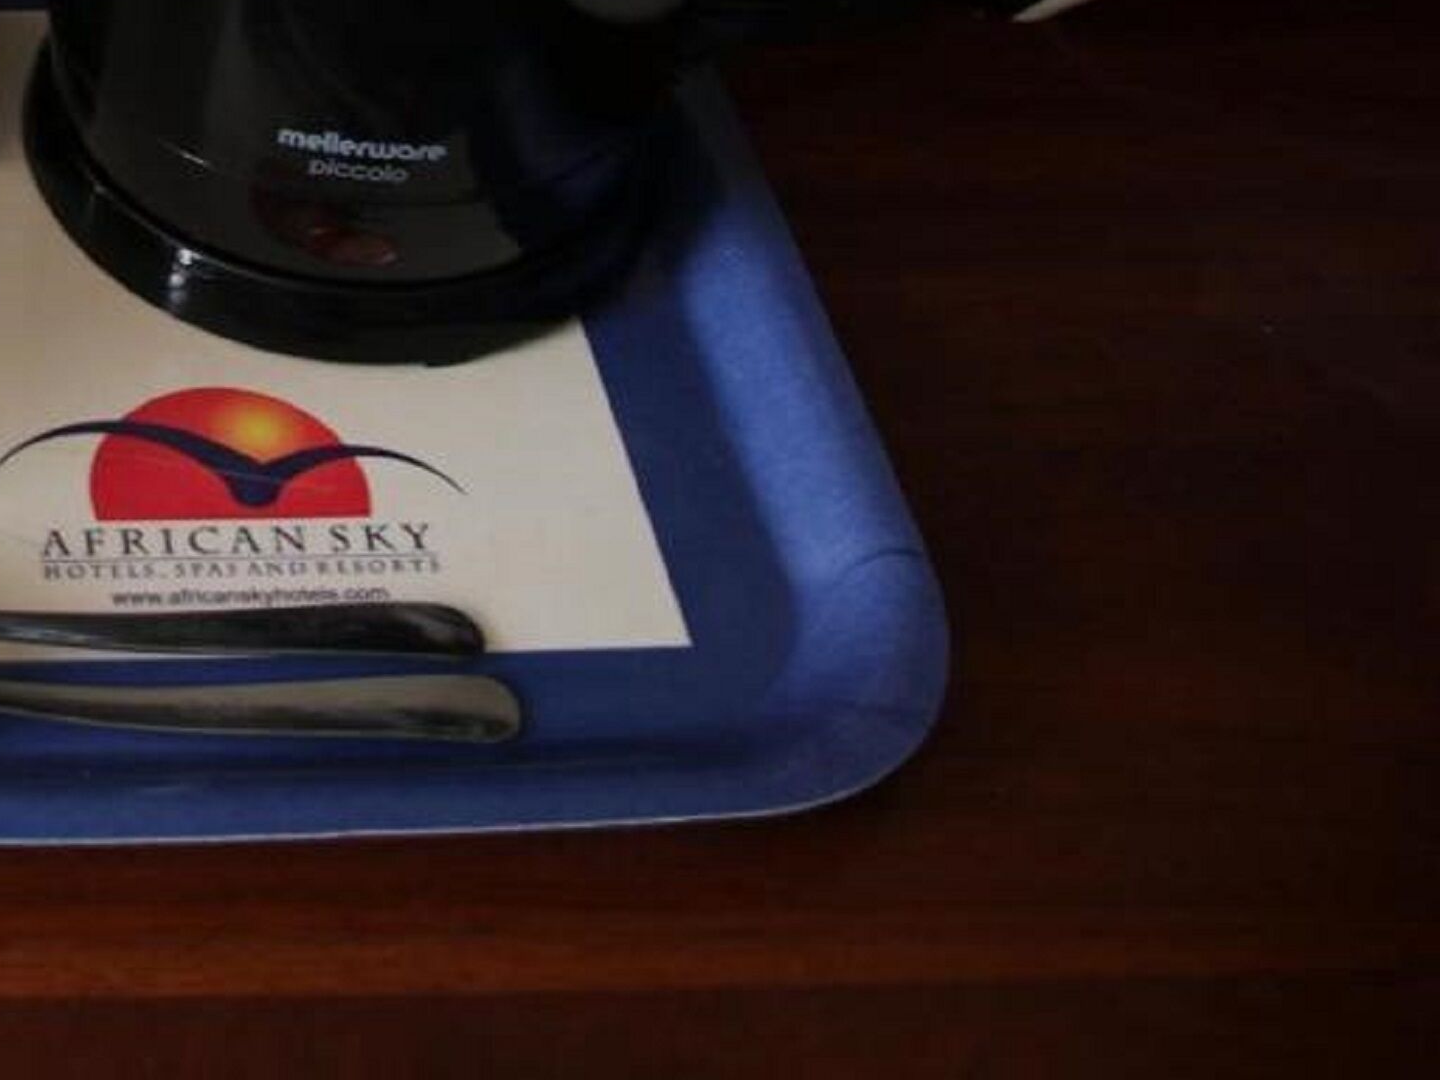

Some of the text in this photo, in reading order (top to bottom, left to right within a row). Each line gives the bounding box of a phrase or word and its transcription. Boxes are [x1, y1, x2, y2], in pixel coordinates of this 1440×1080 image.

[277, 127, 448, 162] mellerware
[309, 159, 409, 184] piccolo
[41, 522, 433, 558] AFRICAN SKY
[175, 559, 238, 579] SPAS
[247, 558, 307, 577] AND
[317, 556, 440, 576] RESORTS
[112, 584, 392, 608] www.africanskyhotels.com
